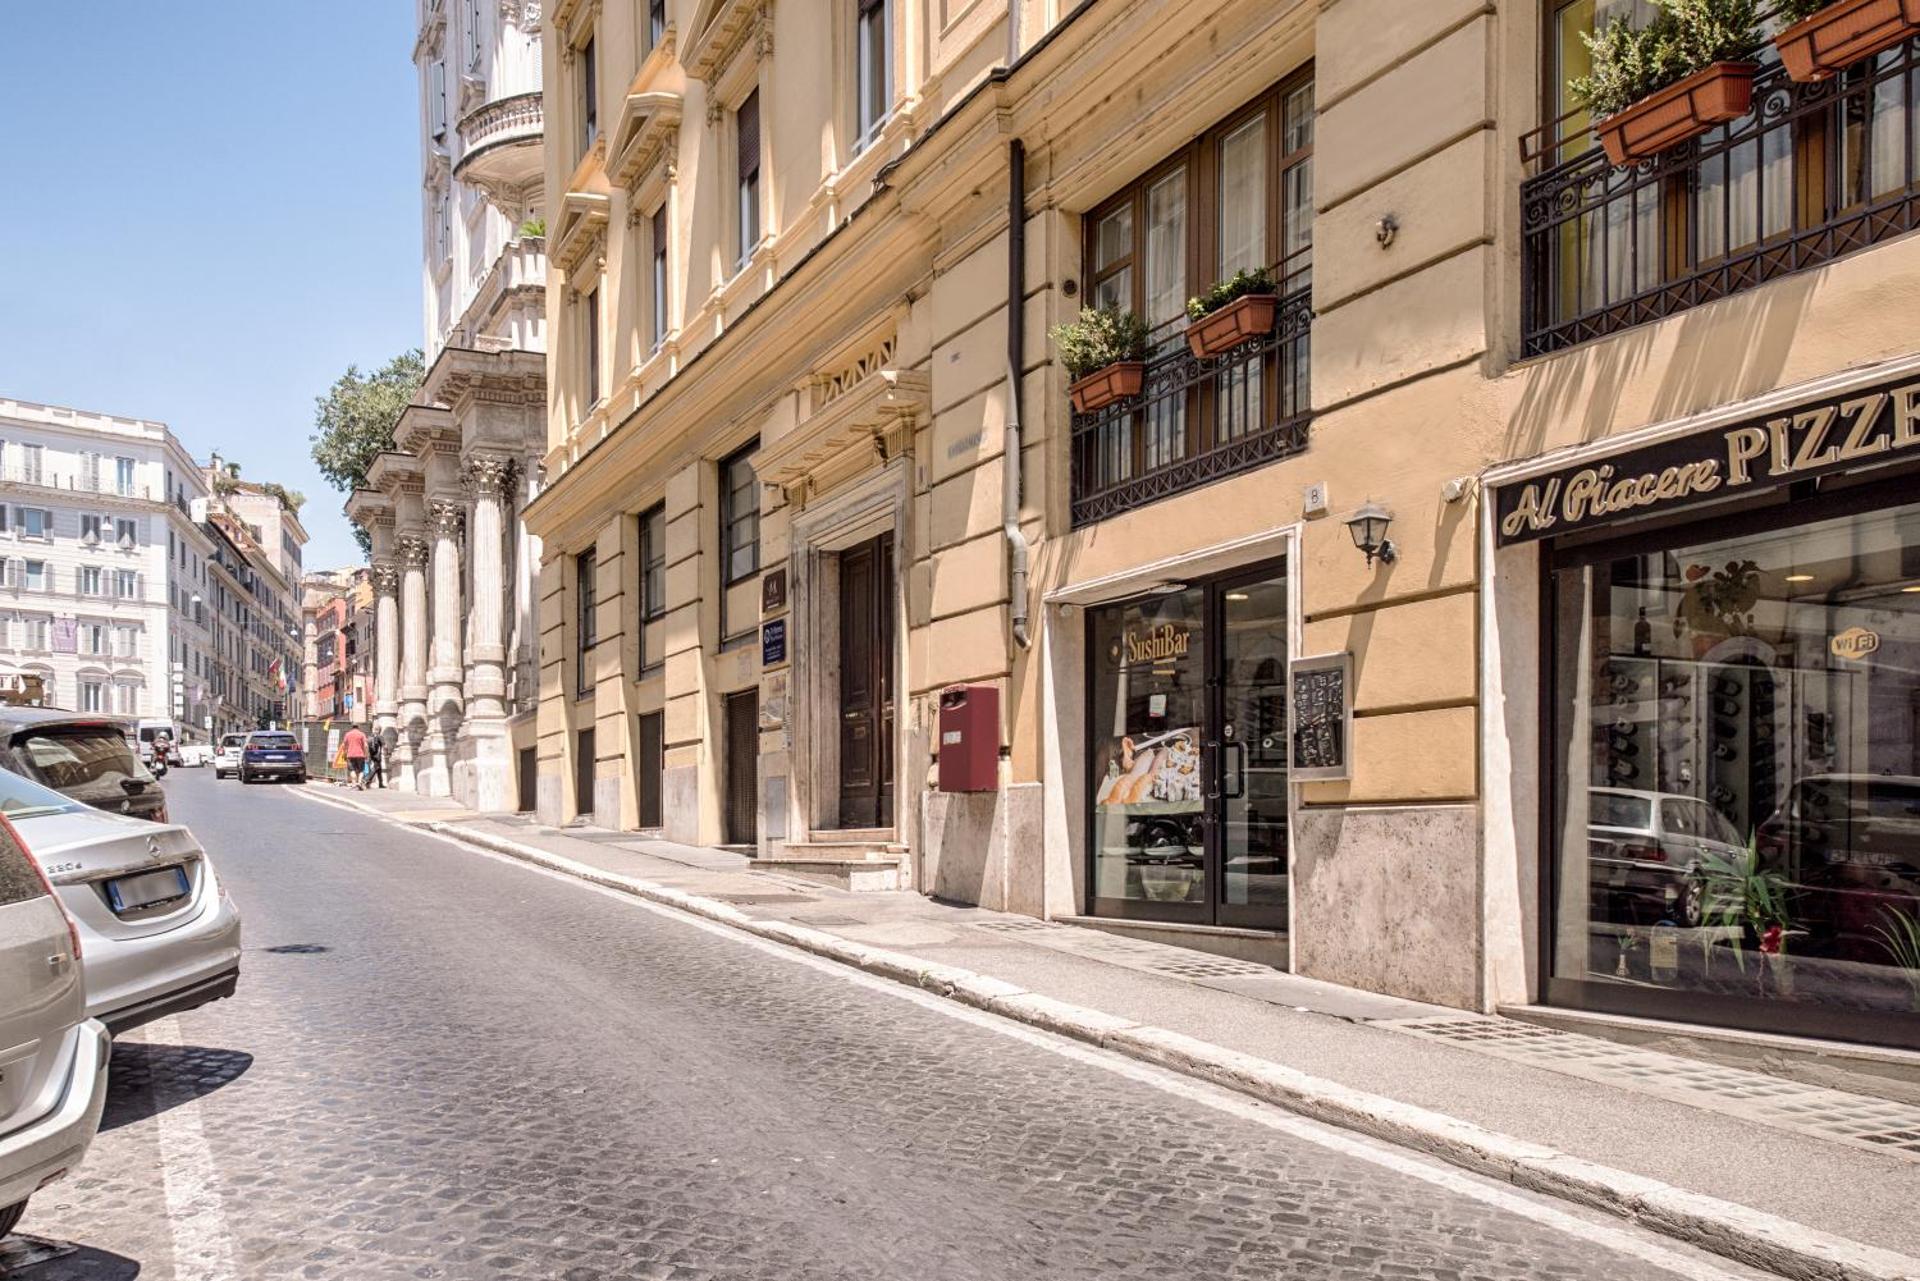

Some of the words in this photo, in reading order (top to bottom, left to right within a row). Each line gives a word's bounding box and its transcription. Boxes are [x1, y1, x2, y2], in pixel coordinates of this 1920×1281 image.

[1311, 489, 1319, 503] 8
[1502, 478, 1560, 536] Al
[1563, 459, 1721, 522] Piacere
